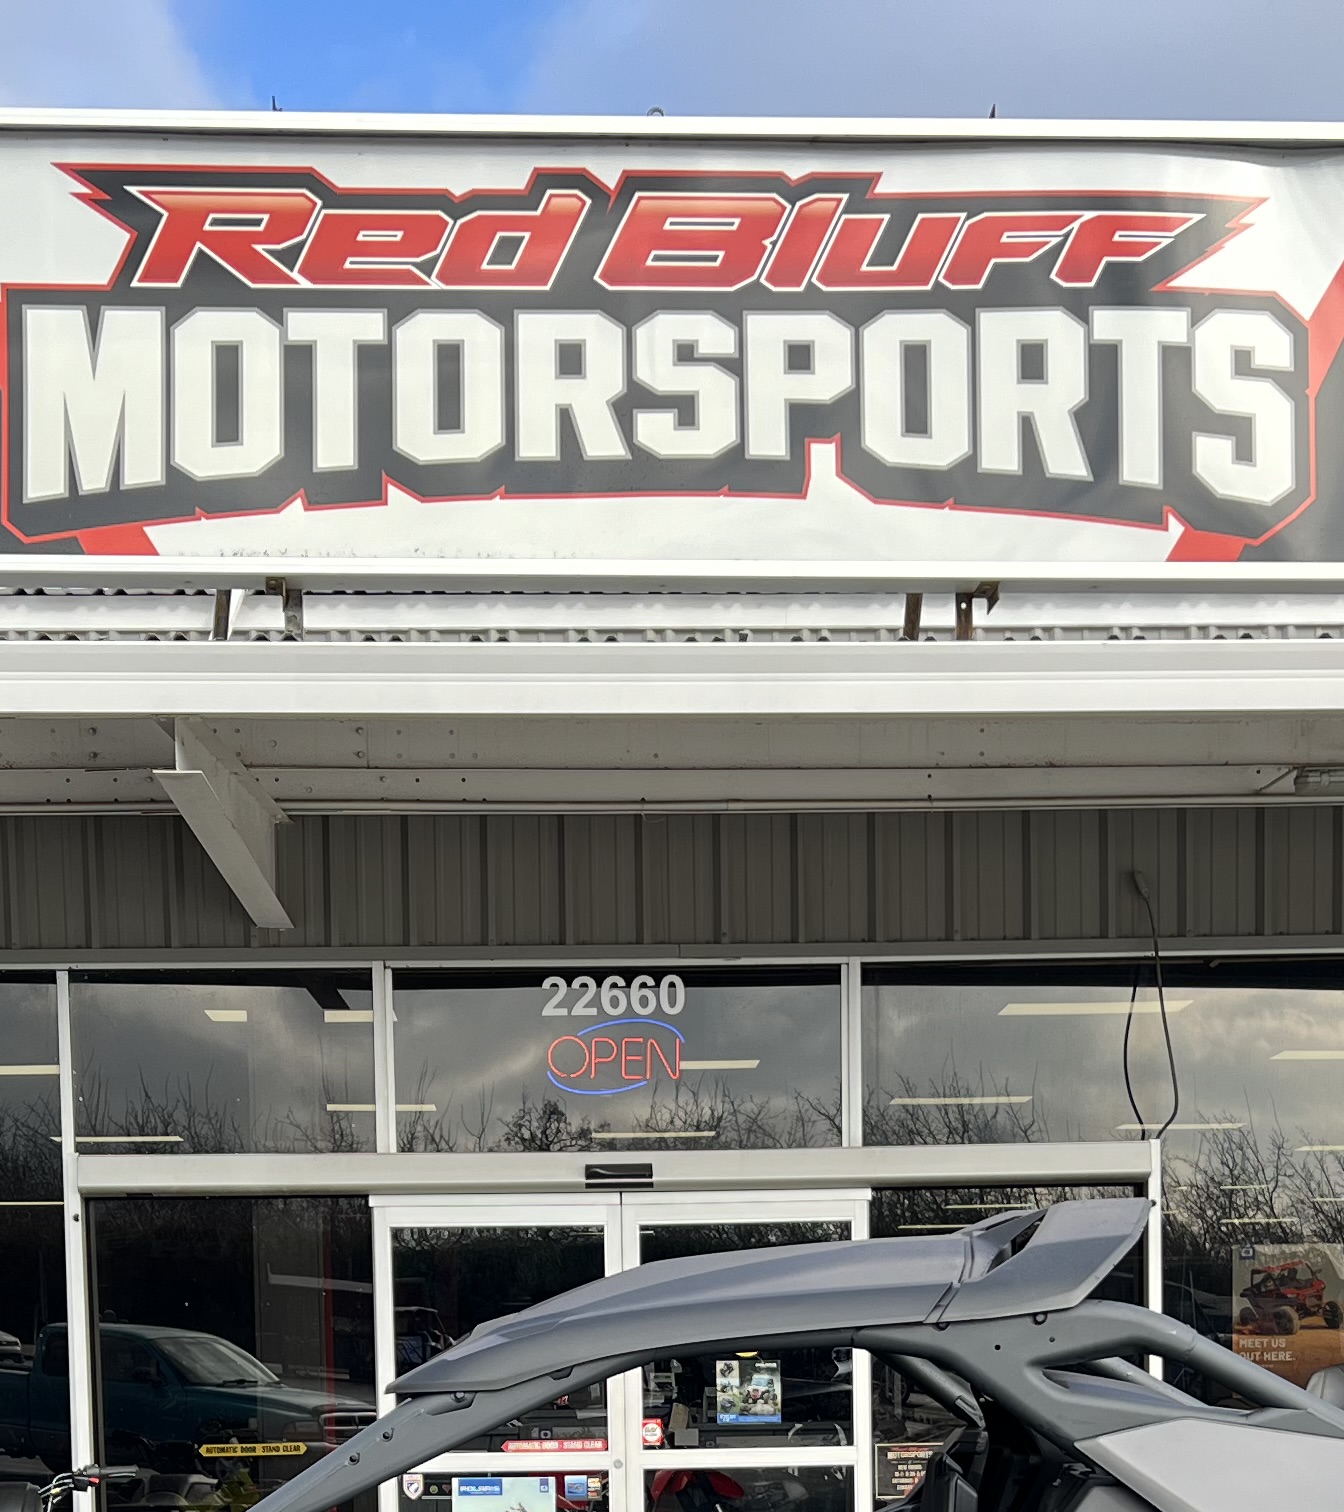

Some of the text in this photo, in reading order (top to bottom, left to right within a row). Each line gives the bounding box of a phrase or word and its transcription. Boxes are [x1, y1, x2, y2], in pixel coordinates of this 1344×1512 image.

[128, 178, 1204, 292] Red Bluff
[22, 302, 1298, 504] MOTORSPORTS
[542, 974, 686, 1017] 22660
[548, 1035, 681, 1080] OPEN
[1239, 1339, 1286, 1348] MEET US
[1263, 1351, 1296, 1361] HERE.
[282, 1444, 301, 1452] CLEAR
